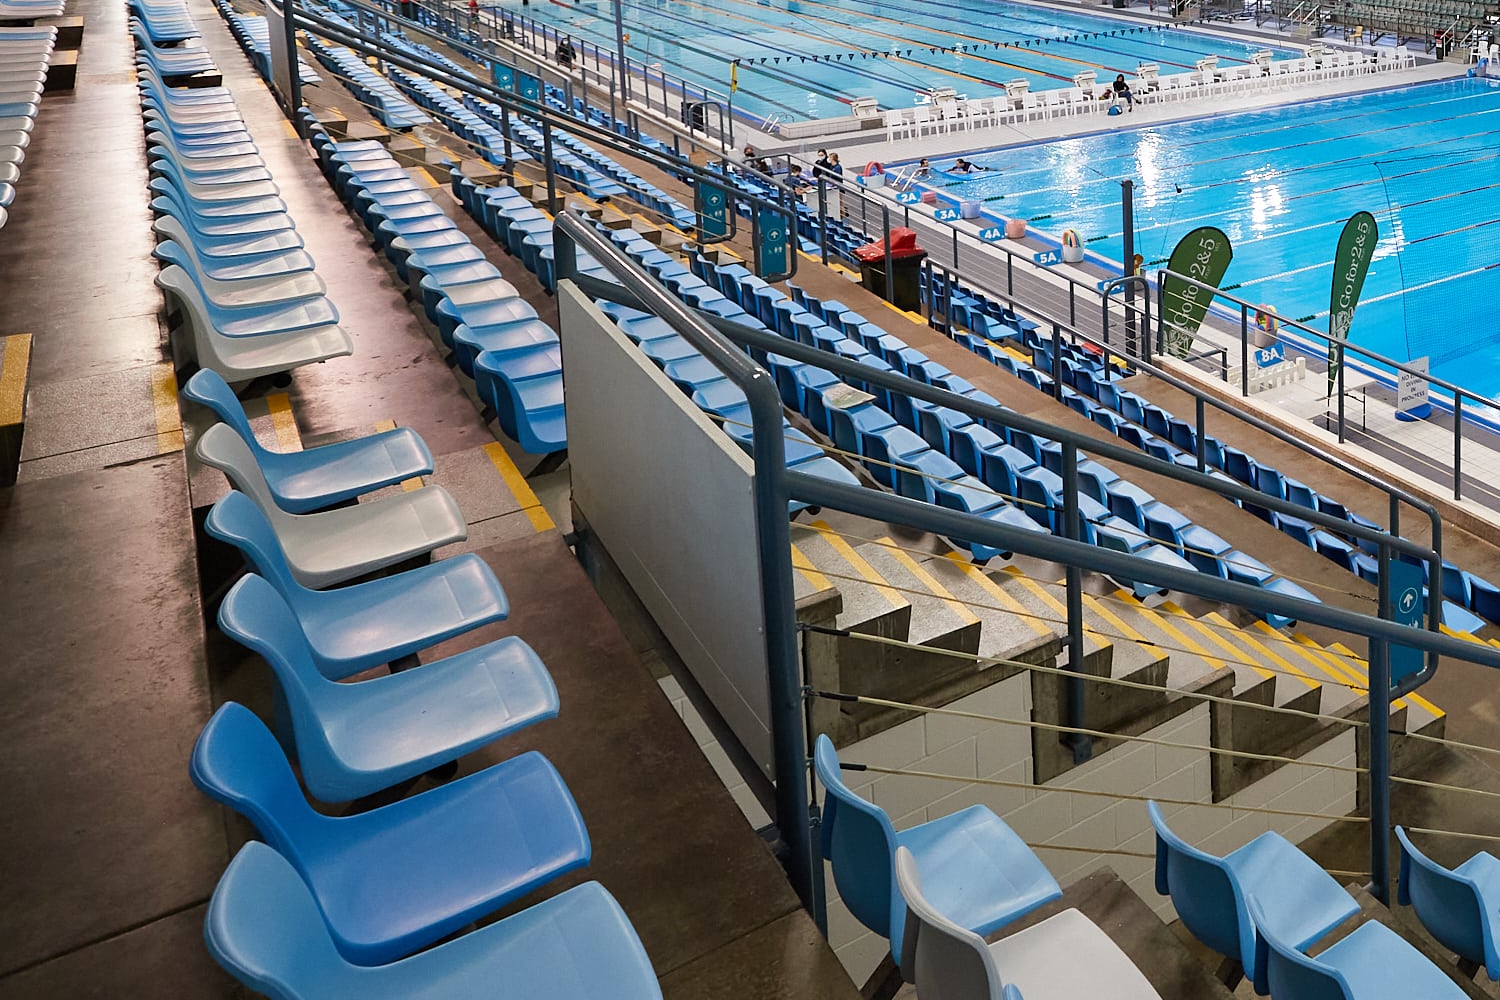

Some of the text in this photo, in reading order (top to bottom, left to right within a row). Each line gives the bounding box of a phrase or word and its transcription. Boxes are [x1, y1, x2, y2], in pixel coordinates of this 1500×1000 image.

[901, 193, 917, 202] 2A
[940, 209, 956, 219] 3A
[984, 228, 1000, 239] 4A
[1040, 252, 1057, 264] 5A
[1345, 259, 1359, 282] for
[1340, 284, 1353, 308] Go
[1174, 302, 1193, 326] Go
[1261, 347, 1279, 362] 8A
